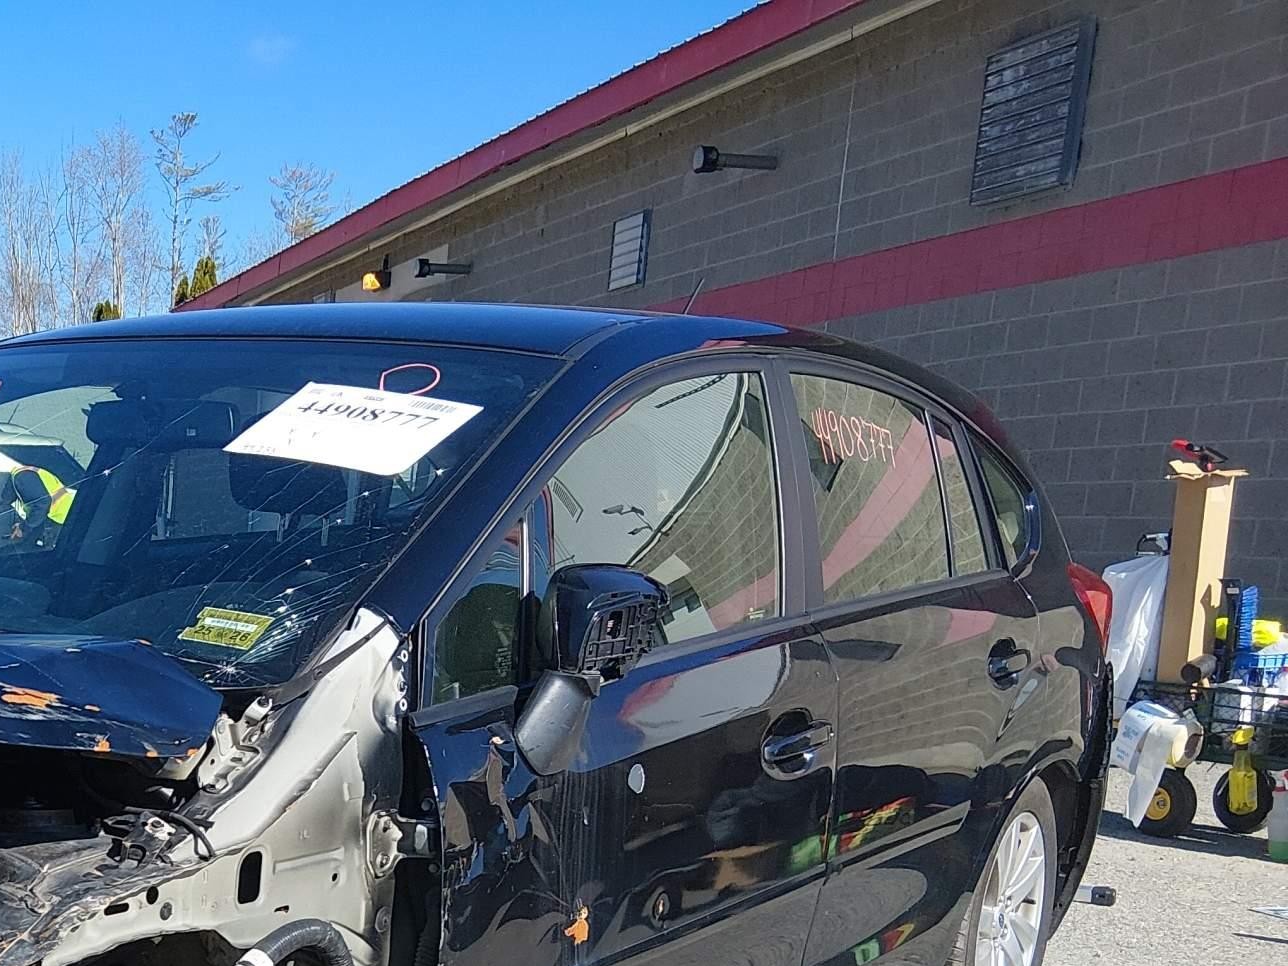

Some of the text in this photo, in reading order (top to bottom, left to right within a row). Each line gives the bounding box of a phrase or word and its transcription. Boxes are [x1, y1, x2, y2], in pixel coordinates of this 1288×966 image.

[297, 400, 440, 429] 44908777
[811, 407, 896, 469] 44908777
[194, 625, 214, 636] 25
[230, 631, 251, 642] 26
